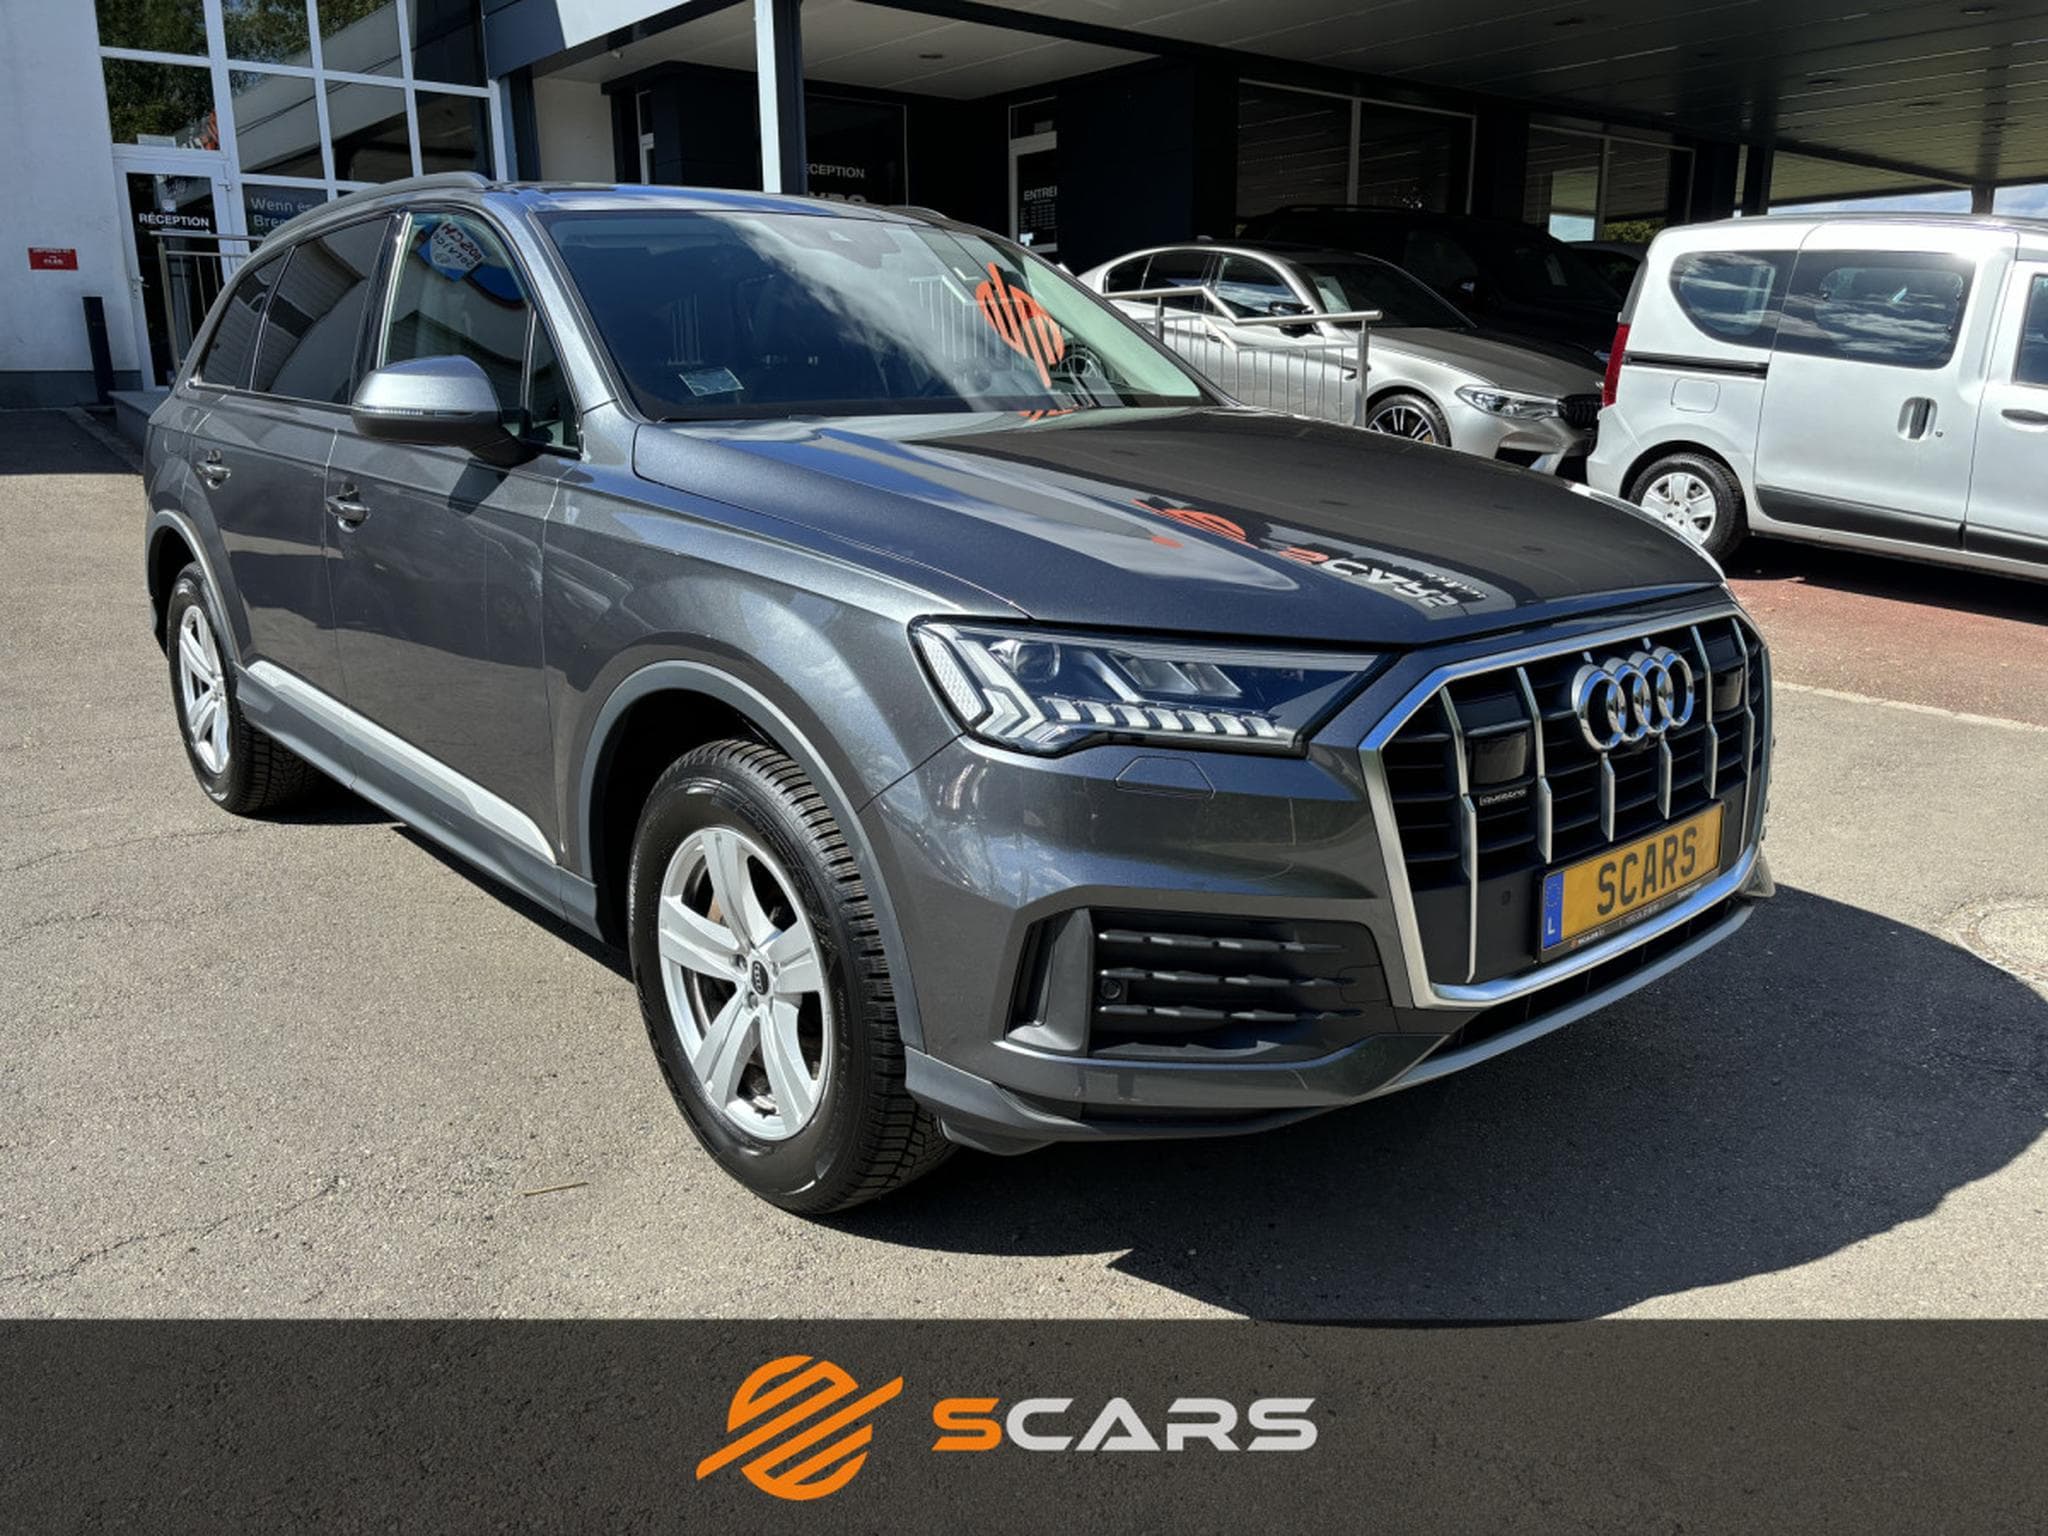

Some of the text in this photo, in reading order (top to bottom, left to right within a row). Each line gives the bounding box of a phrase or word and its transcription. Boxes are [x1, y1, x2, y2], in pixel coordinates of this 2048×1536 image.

[251, 197, 294, 213] Wenn
[139, 211, 209, 227] RÉCEPTION
[1597, 827, 1697, 915] SCARS
[1547, 916, 1556, 936] L
